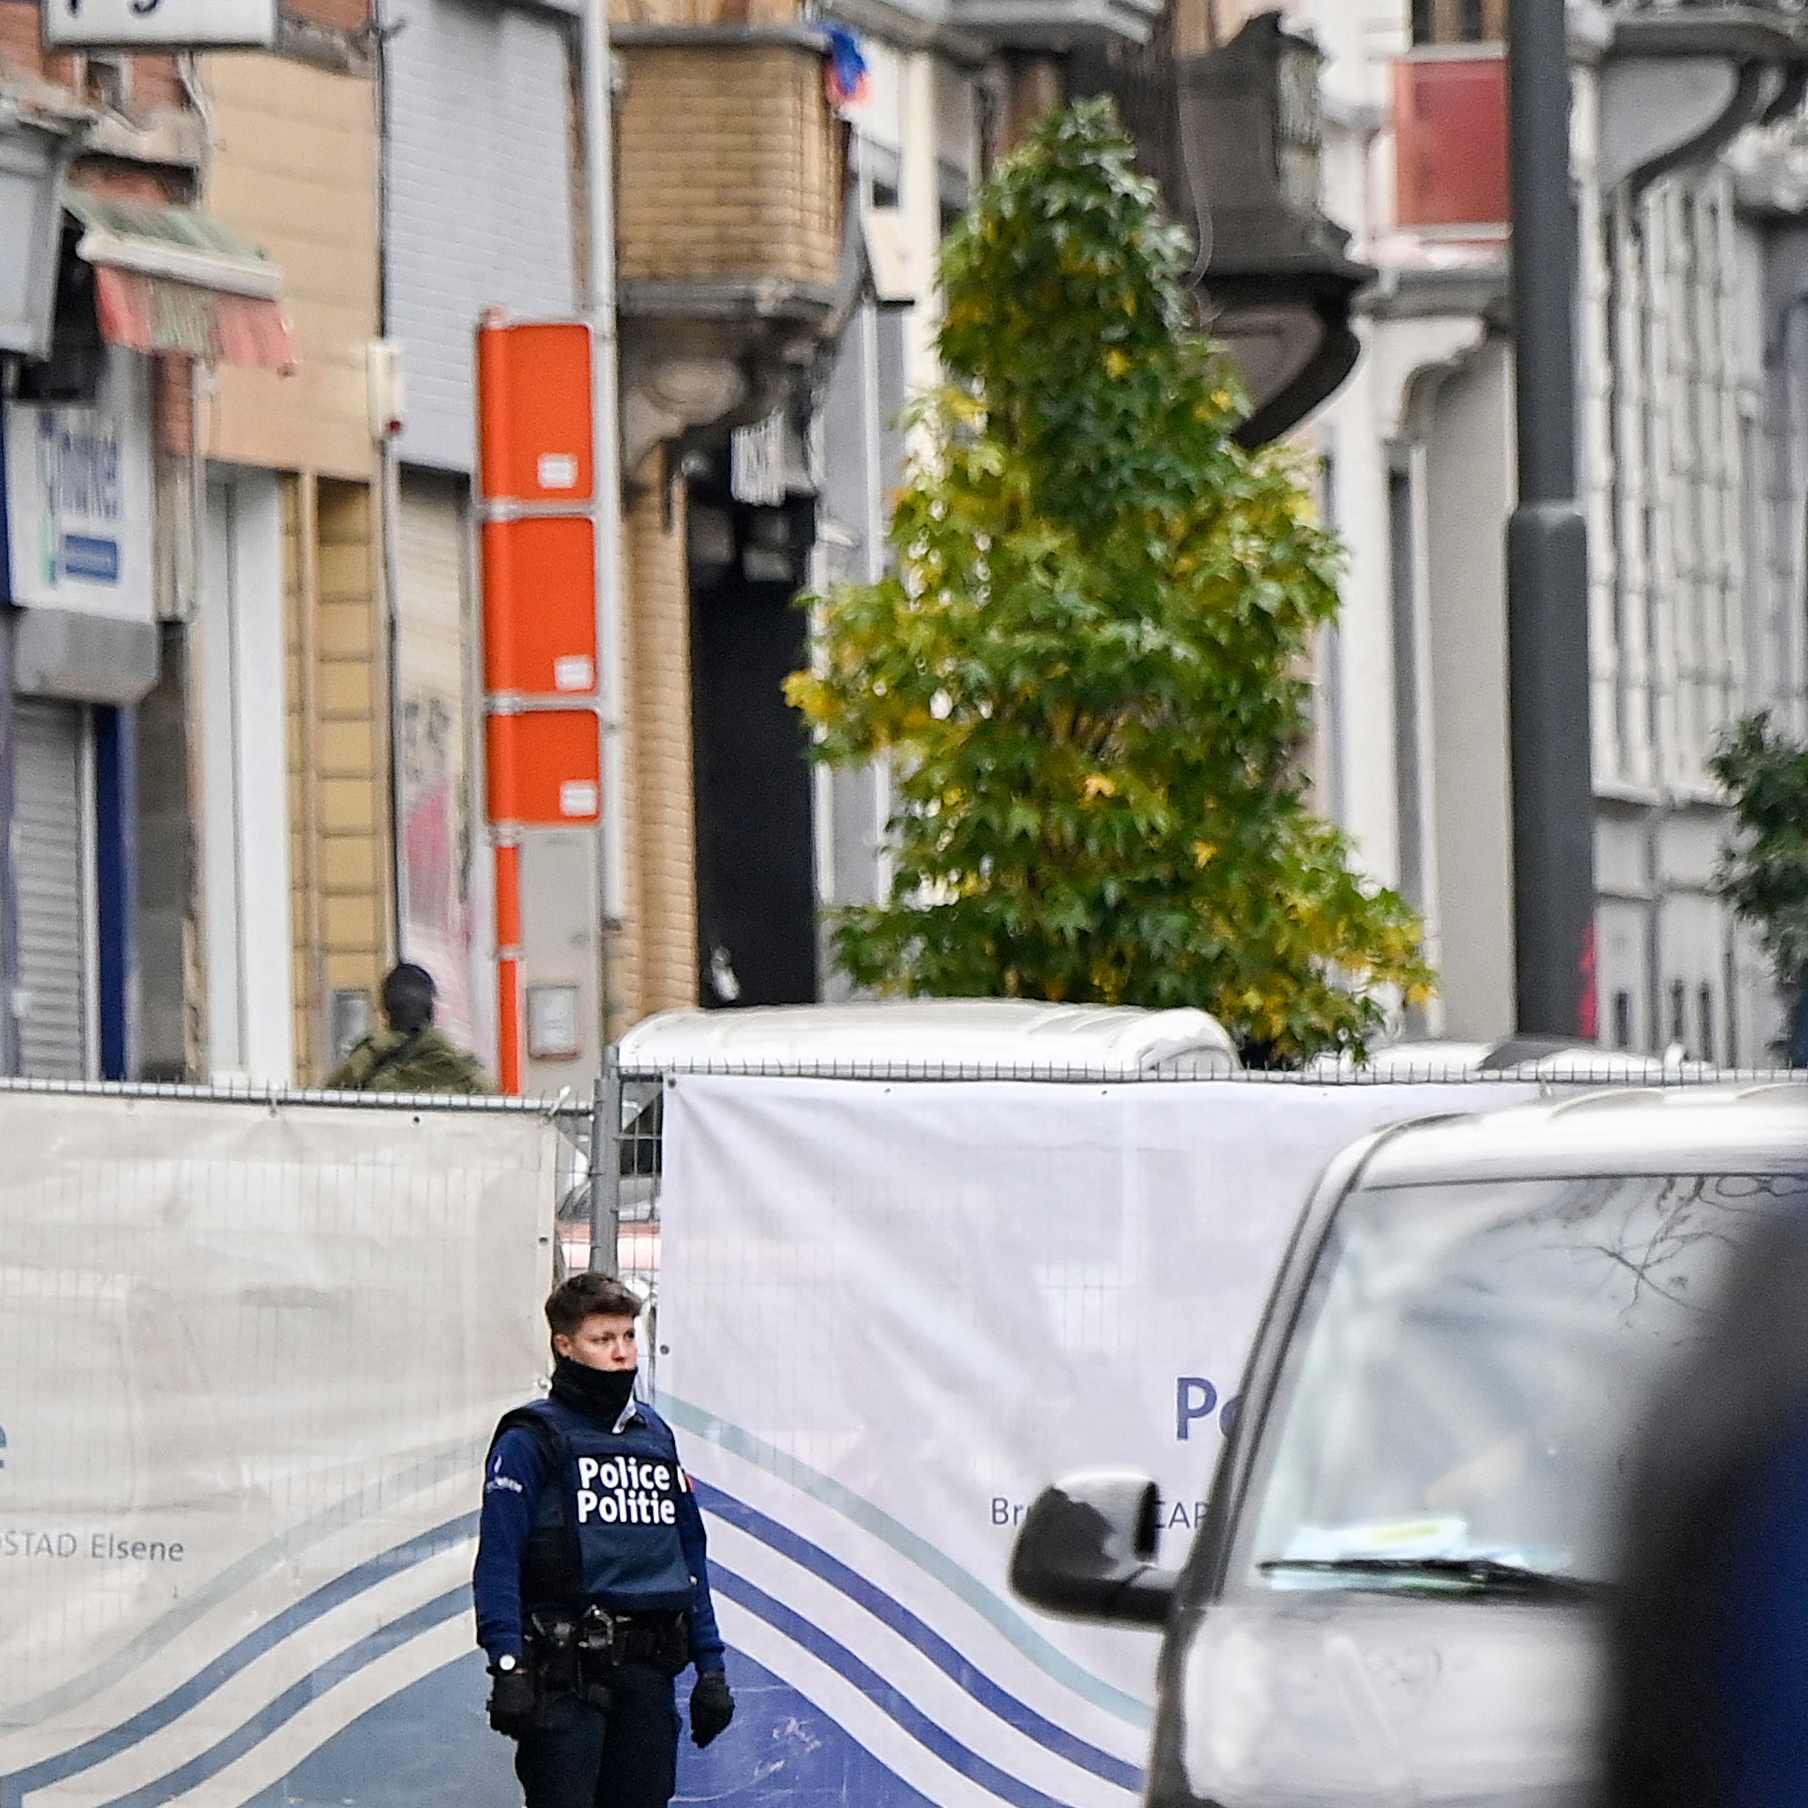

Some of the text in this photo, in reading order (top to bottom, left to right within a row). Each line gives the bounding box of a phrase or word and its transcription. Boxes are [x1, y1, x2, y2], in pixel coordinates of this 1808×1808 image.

[577, 1456, 670, 1490] Police
[576, 1489, 676, 1524] Politie
[92, 1533, 185, 1562] Elsene
